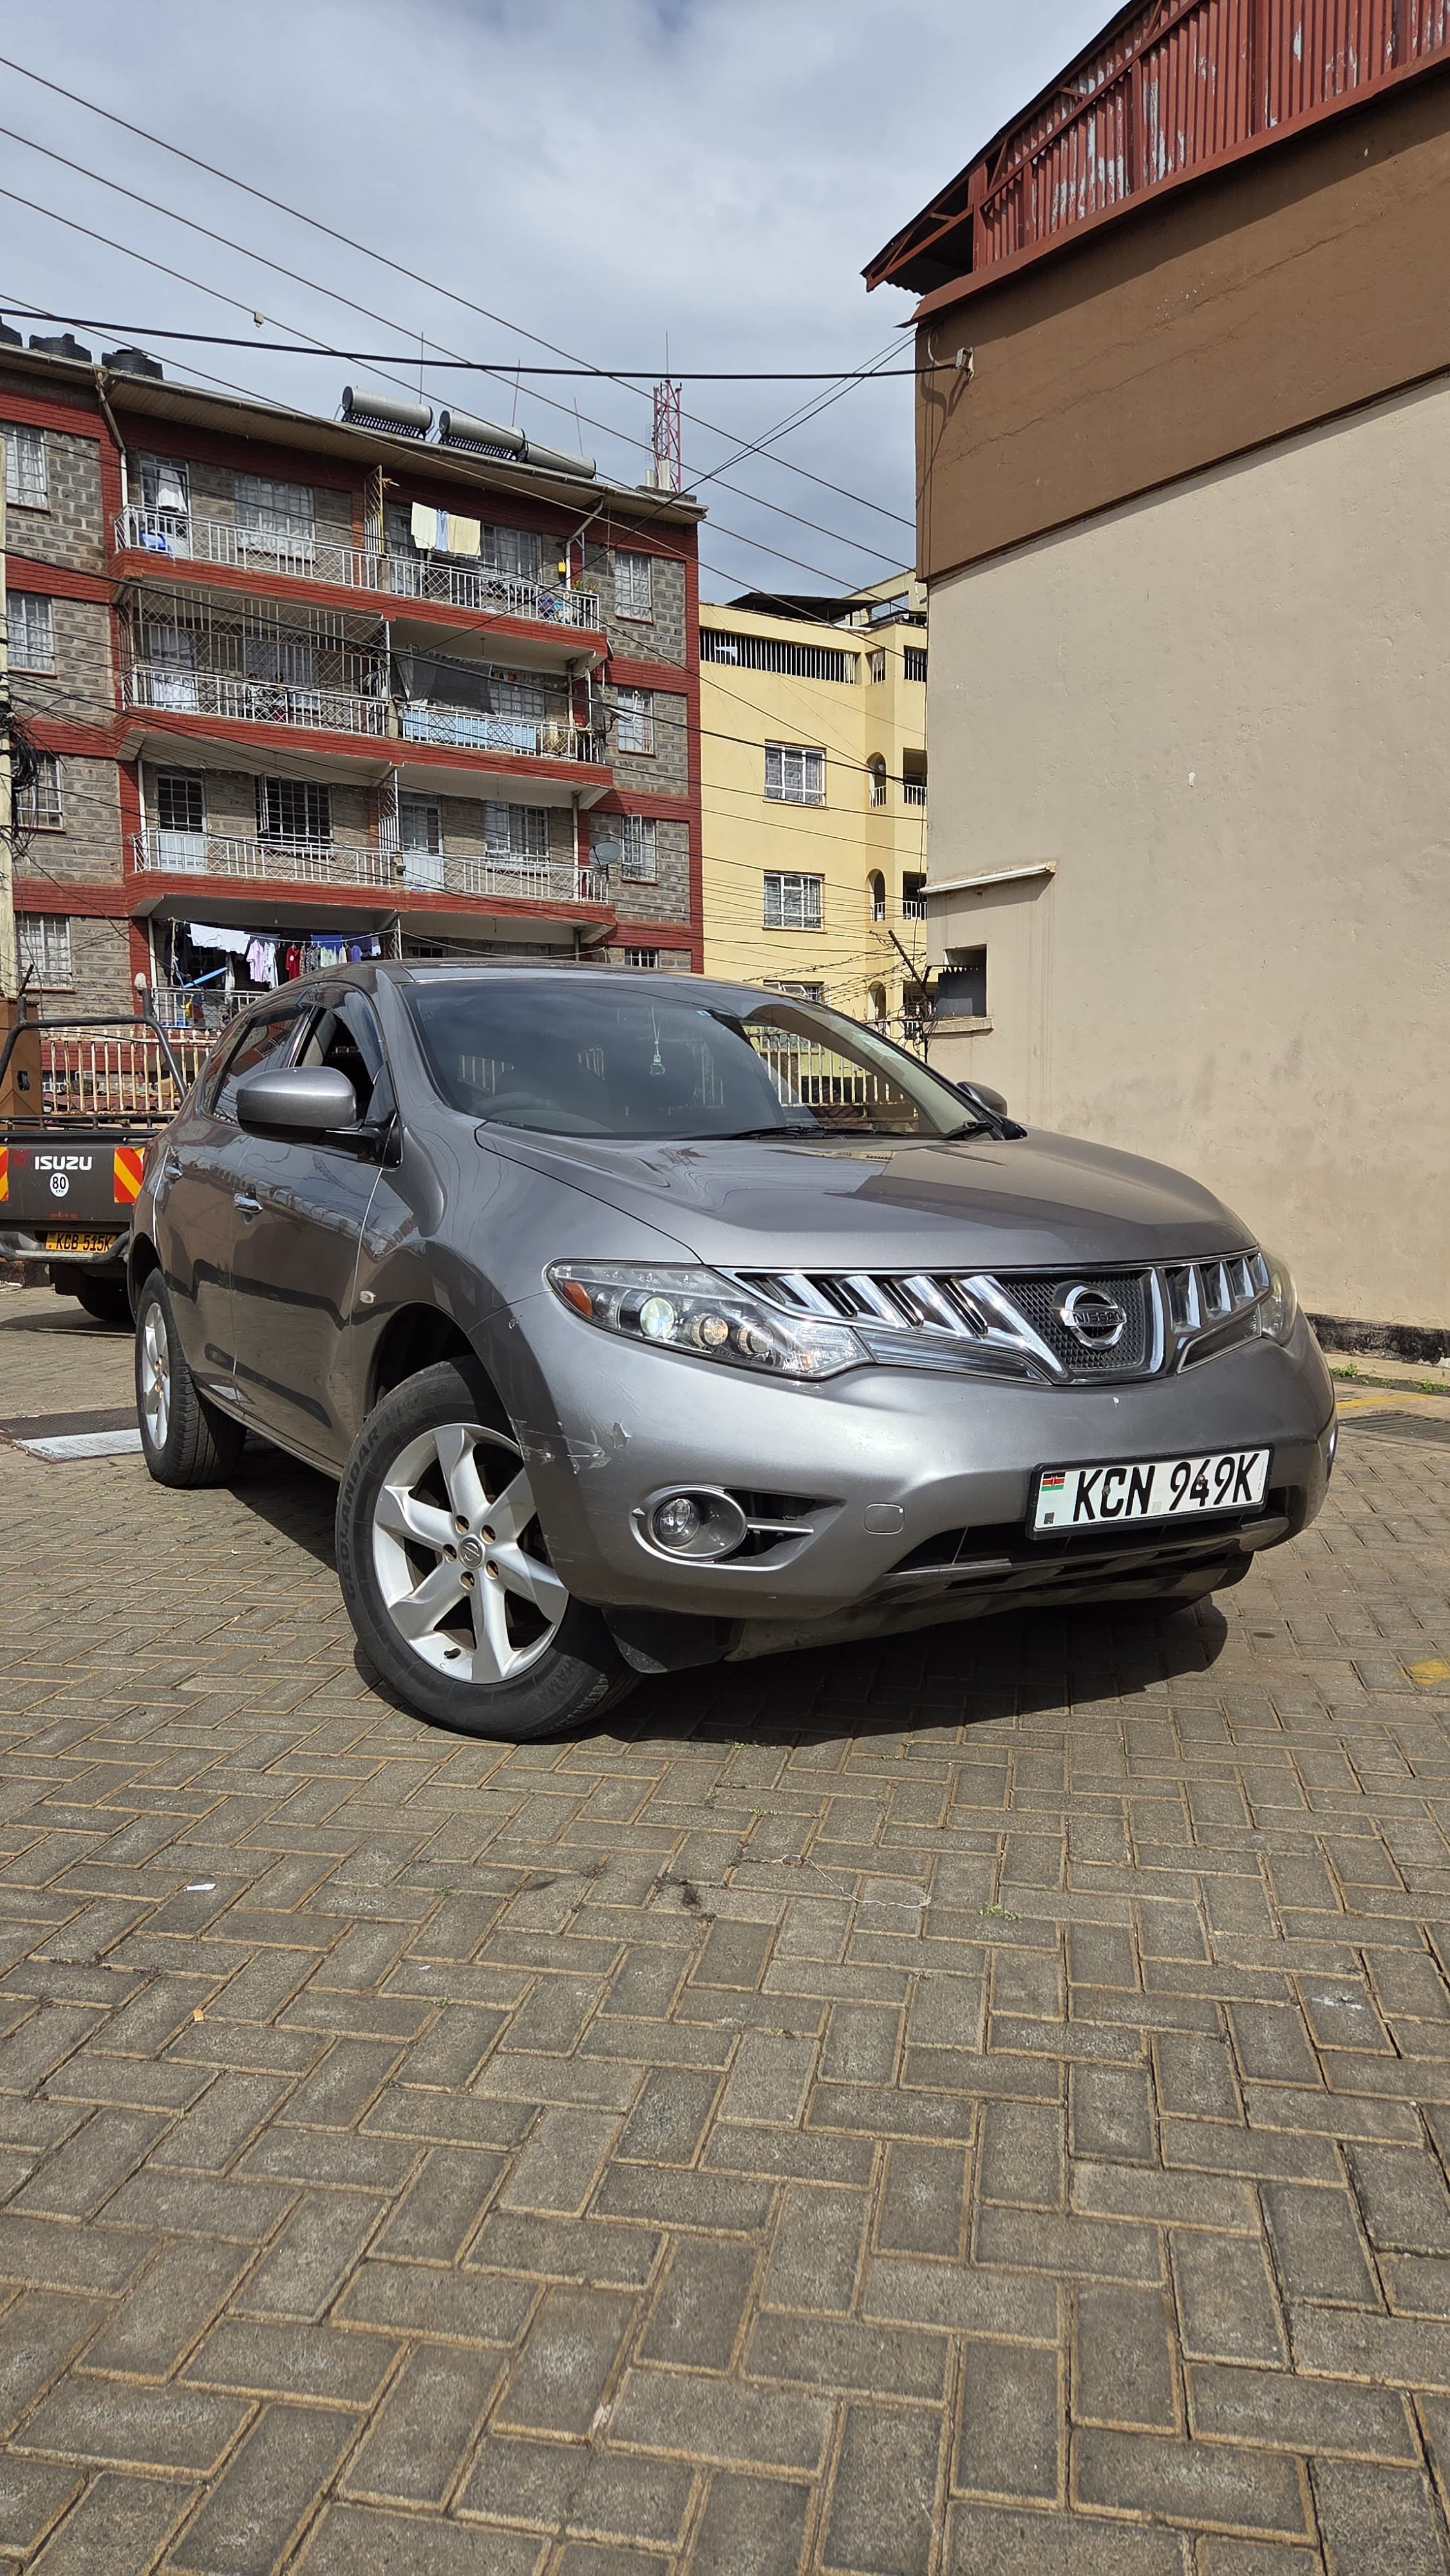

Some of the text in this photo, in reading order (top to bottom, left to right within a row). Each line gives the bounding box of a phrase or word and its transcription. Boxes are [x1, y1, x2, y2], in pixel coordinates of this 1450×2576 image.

[35, 1155, 93, 1171] ISUZU
[52, 1176, 66, 1189] 80
[55, 1233, 113, 1252] KCB 515K
[1073, 1310, 1124, 1325] NISSAN
[1073, 1464, 1156, 1522] KCN
[1169, 1452, 1260, 1512] 949K
[339, 1425, 381, 1601] GEOLANDAR
